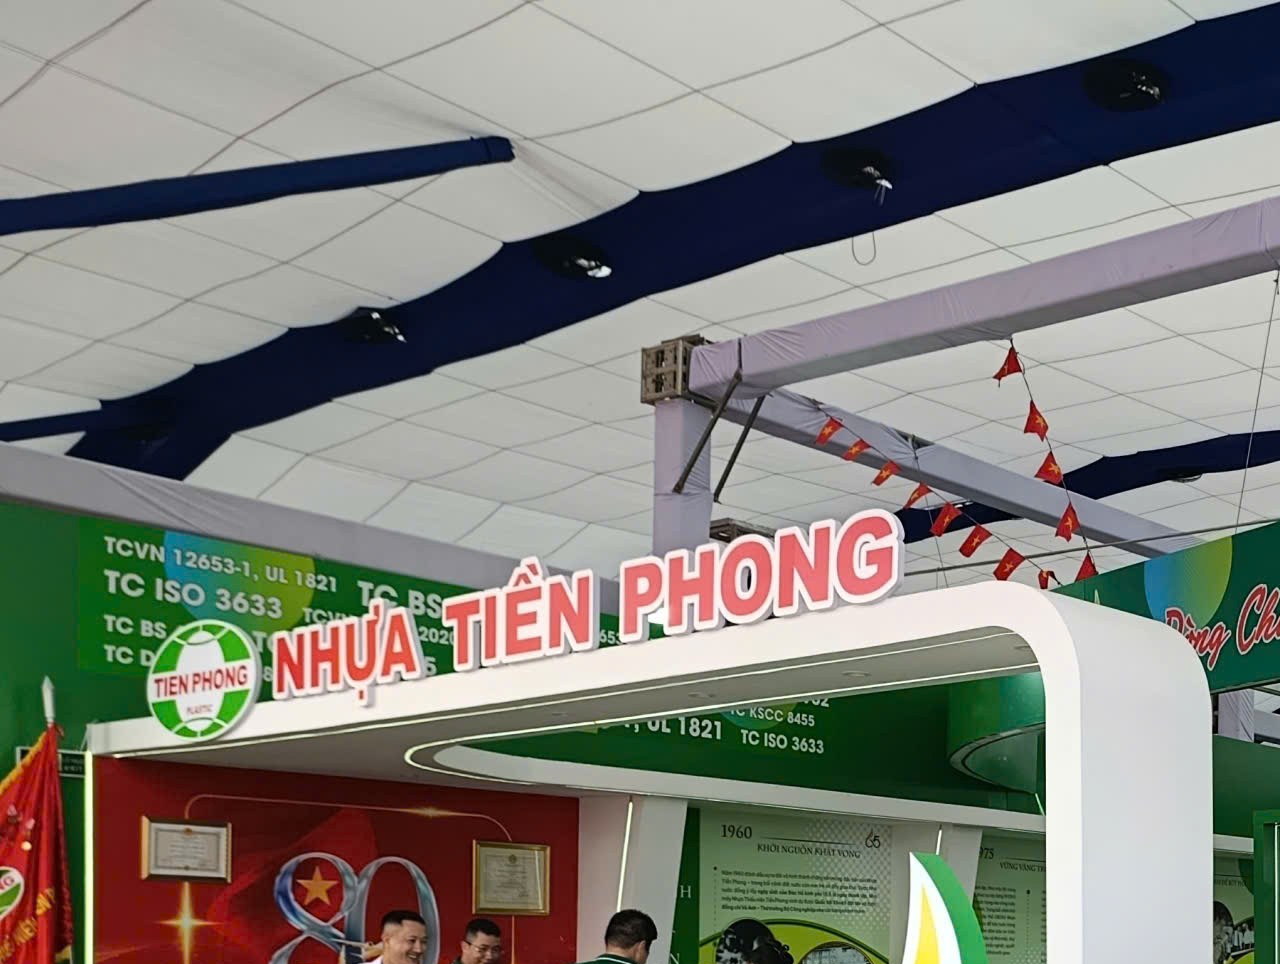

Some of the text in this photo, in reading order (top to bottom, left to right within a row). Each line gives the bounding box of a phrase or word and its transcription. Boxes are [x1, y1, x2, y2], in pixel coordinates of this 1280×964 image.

[104, 535, 165, 563] TCVN
[265, 565, 288, 584] UL
[295, 570, 337, 593] 1821
[104, 569, 283, 619] TC ISO 3633
[408, 590, 442, 619] BS
[273, 513, 897, 703] NHỰA TIỀN PHONG
[104, 614, 167, 639] TC BS
[104, 644, 134, 665] TC
[154, 674, 189, 698] TIEN
[192, 665, 248, 693] PHONG
[678, 716, 723, 740] 1821
[749, 707, 785, 722] KSCC
[787, 711, 815, 727] 8455
[740, 729, 825, 754] TC ISO 3633
[720, 824, 752, 839] 1960
